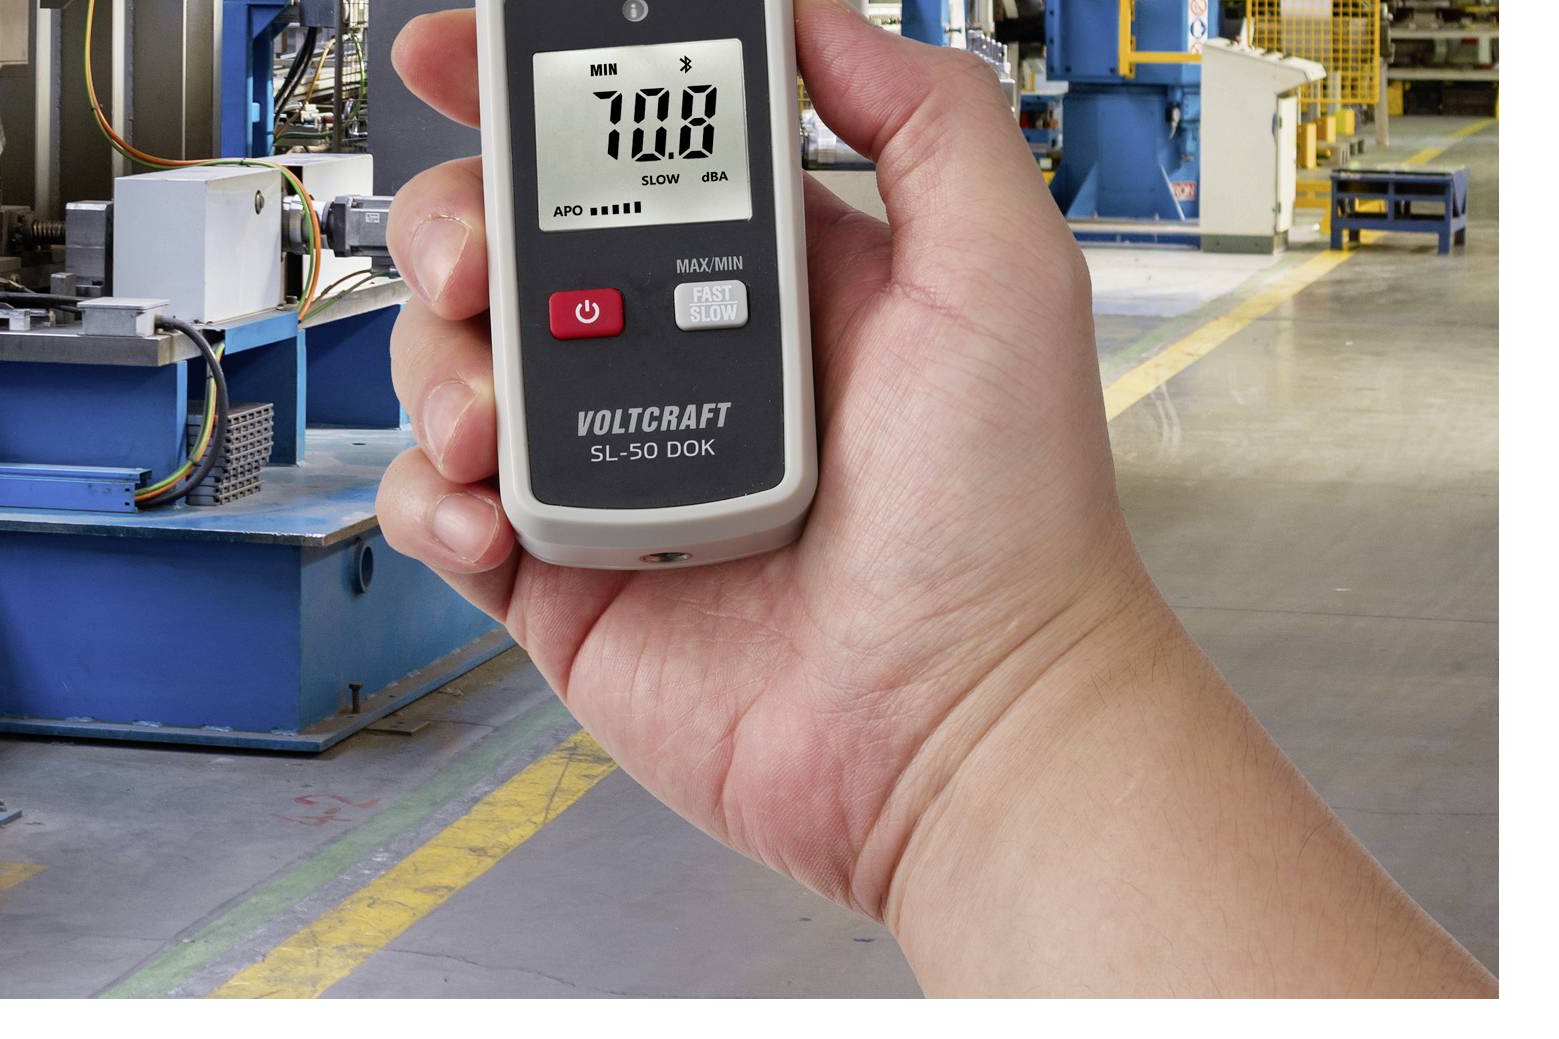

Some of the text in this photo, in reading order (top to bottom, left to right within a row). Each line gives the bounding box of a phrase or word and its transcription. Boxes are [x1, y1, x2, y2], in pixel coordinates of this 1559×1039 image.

[590, 63, 618, 77] MIN
[592, 84, 718, 162] 70.8
[641, 171, 729, 186] SLOW dBA
[553, 205, 583, 217] APO
[676, 255, 743, 274] MAX/MIN
[693, 285, 732, 302] FAST
[689, 303, 738, 323] SLOW
[576, 401, 732, 437] VOLTCRAFT
[590, 438, 716, 462] SL-50 DOK
